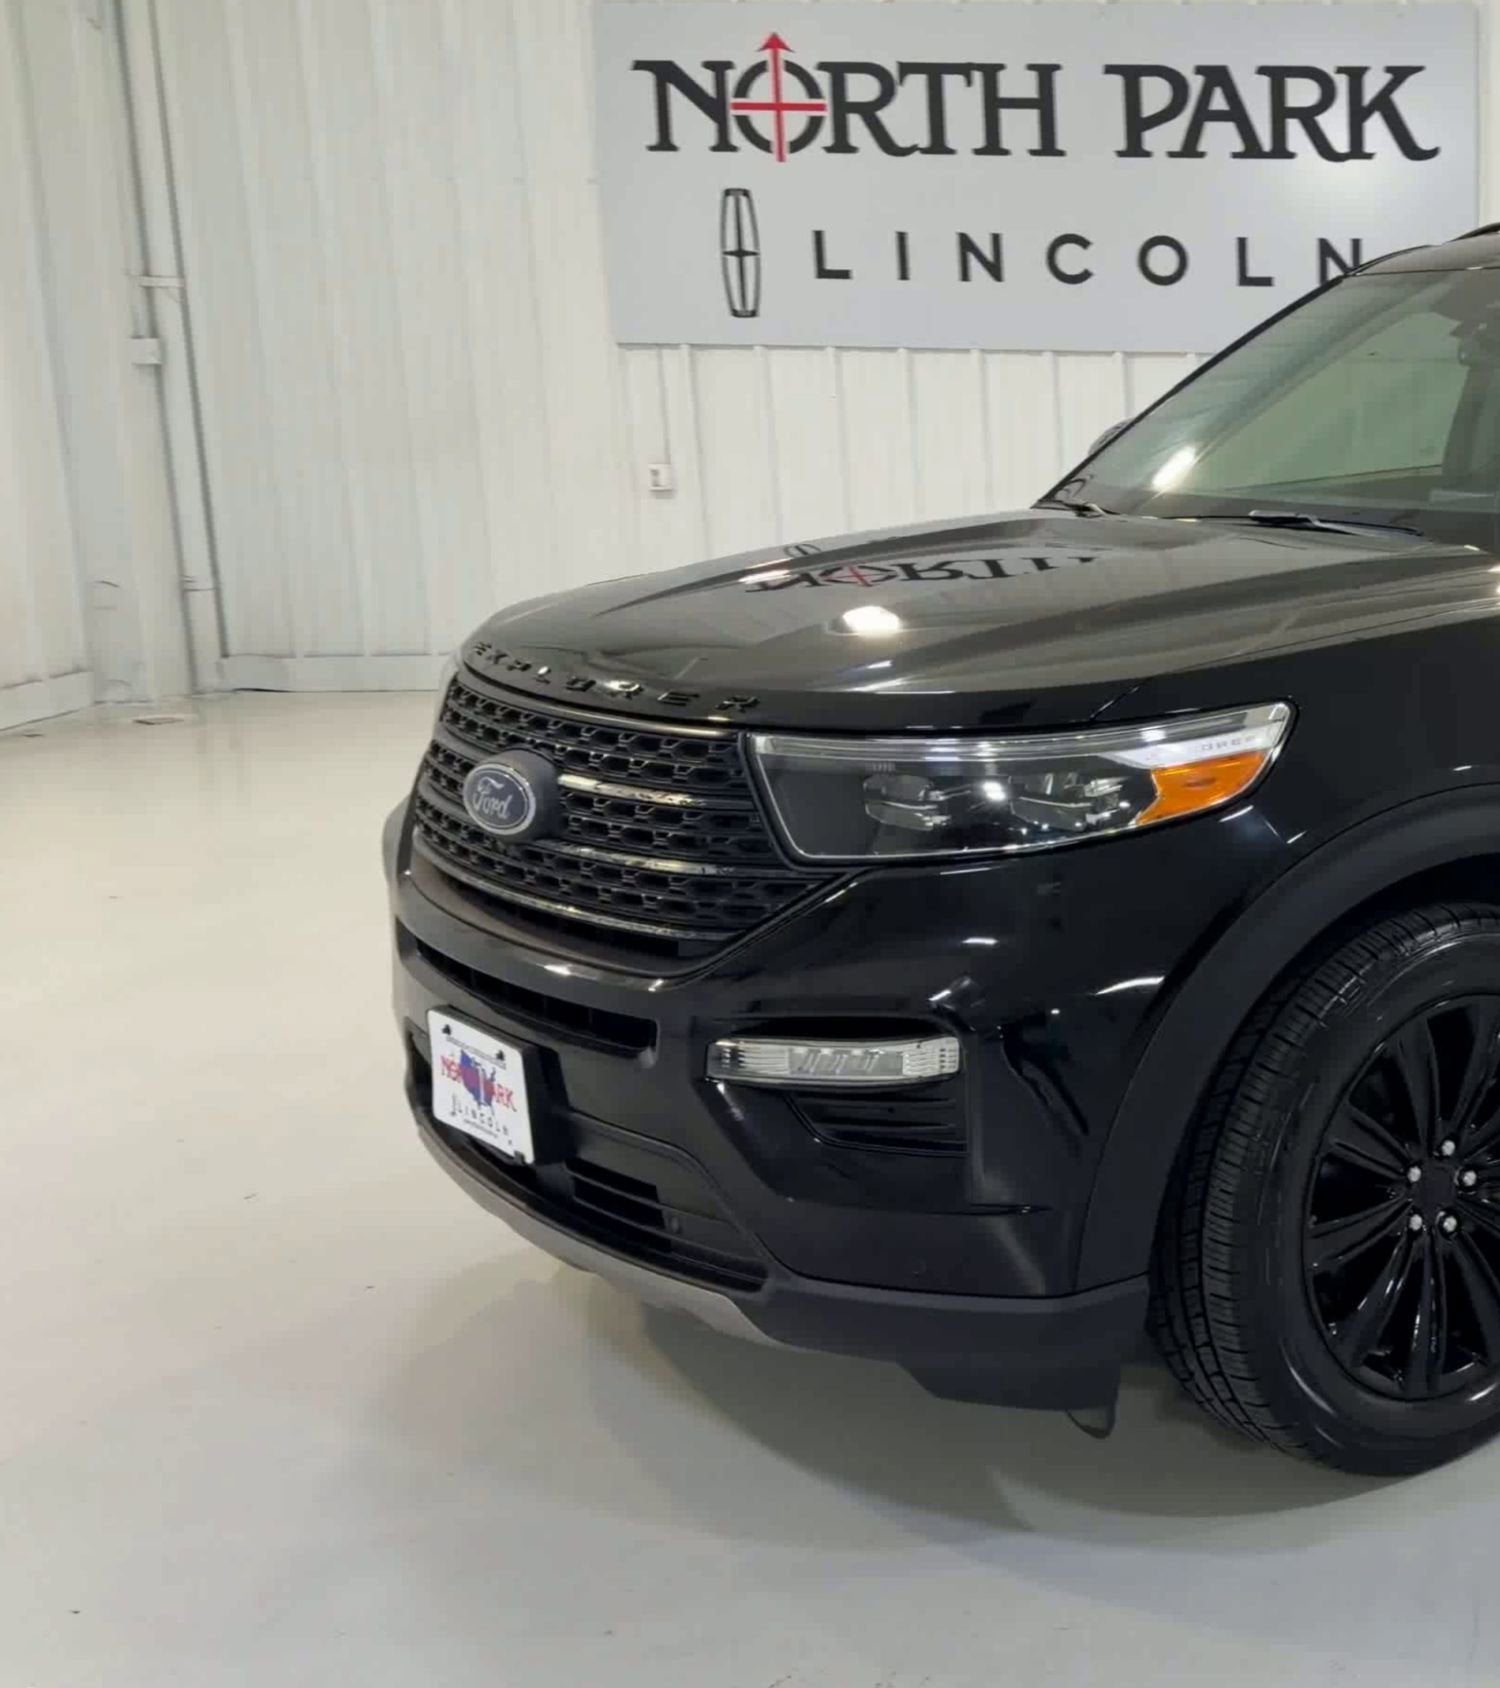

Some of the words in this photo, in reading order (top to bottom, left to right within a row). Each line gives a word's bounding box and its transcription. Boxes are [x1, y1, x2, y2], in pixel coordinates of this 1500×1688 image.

[632, 59, 1066, 157] NORTH
[1104, 64, 1442, 161] PARK
[813, 230, 1363, 287] LINCOLN
[472, 776, 512, 820] Ford
